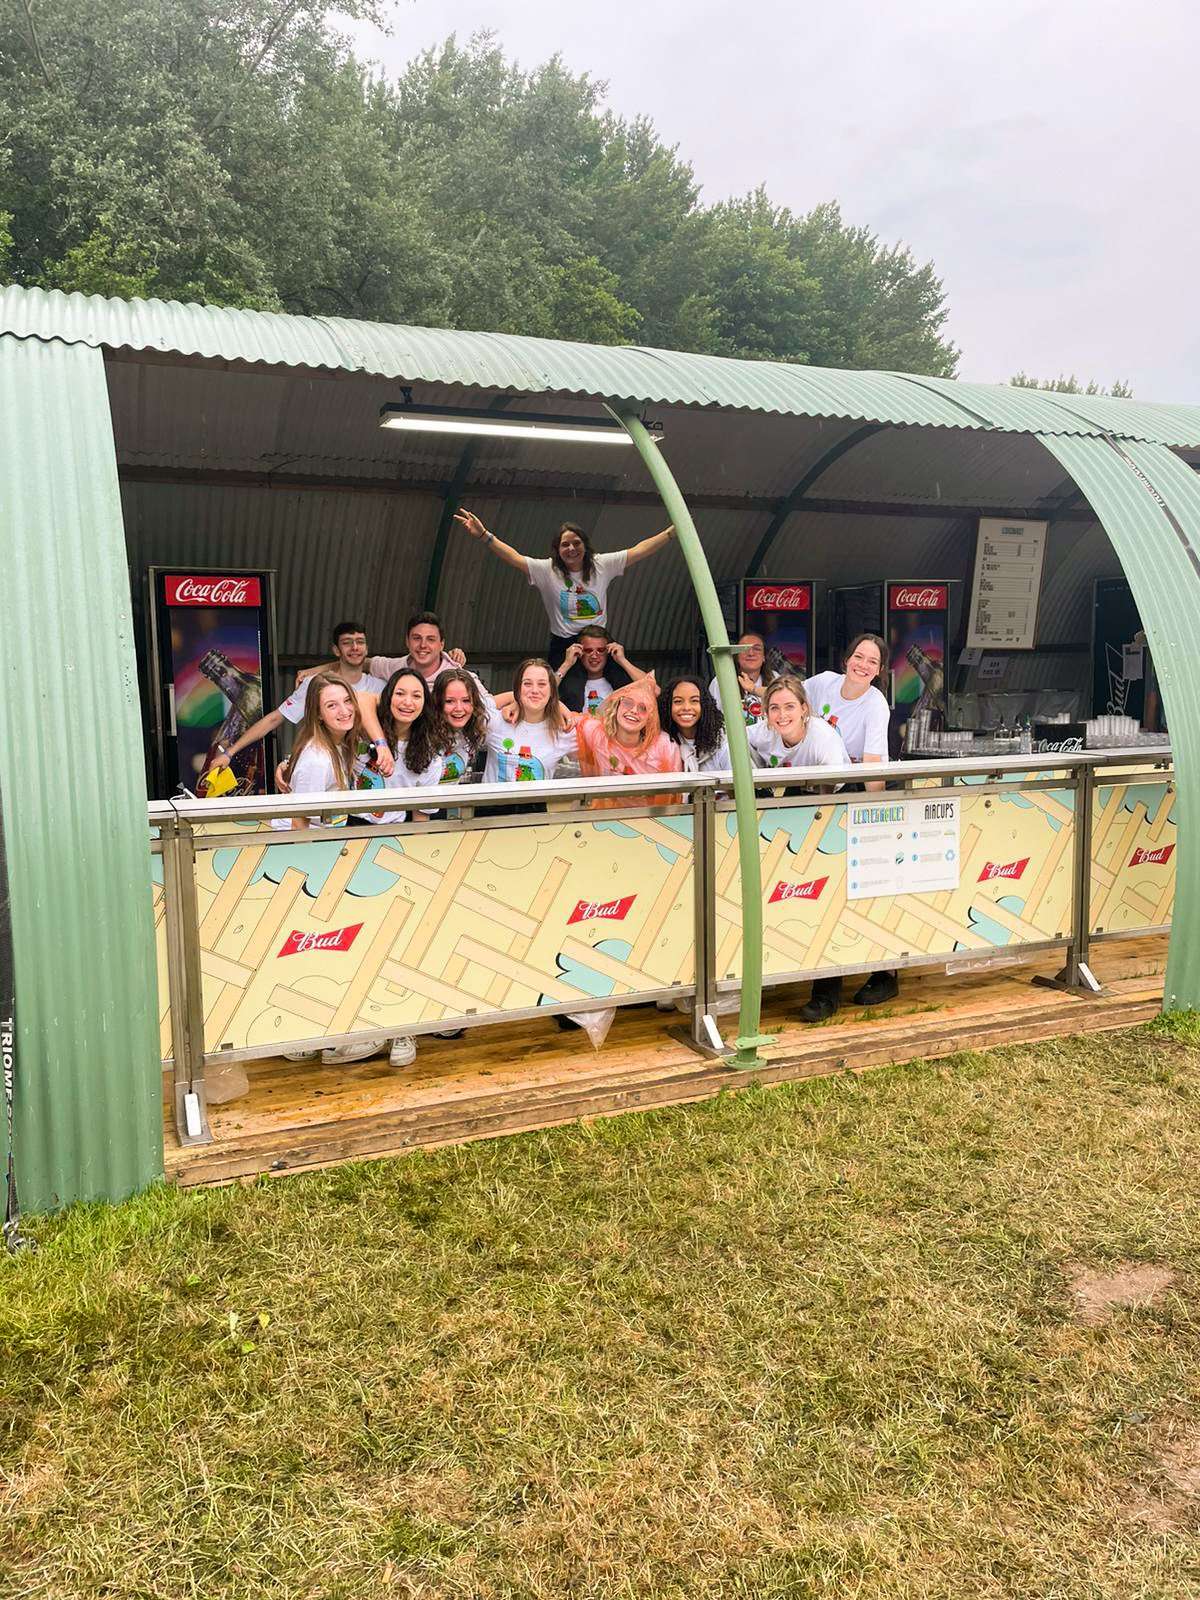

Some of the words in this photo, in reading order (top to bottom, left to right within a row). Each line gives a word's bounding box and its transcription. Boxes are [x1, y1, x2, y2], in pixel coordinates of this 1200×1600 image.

[175, 578, 250, 603] Coca-Cola
[752, 587, 802, 608] Coca-Cola
[896, 587, 940, 607] Coca-Cola
[924, 803, 954, 821] AIRCUPS
[1136, 847, 1165, 863] Bud
[986, 861, 1018, 880] Bud
[779, 880, 816, 900] Bud
[578, 899, 621, 921] Bud
[292, 928, 345, 952] Bud
